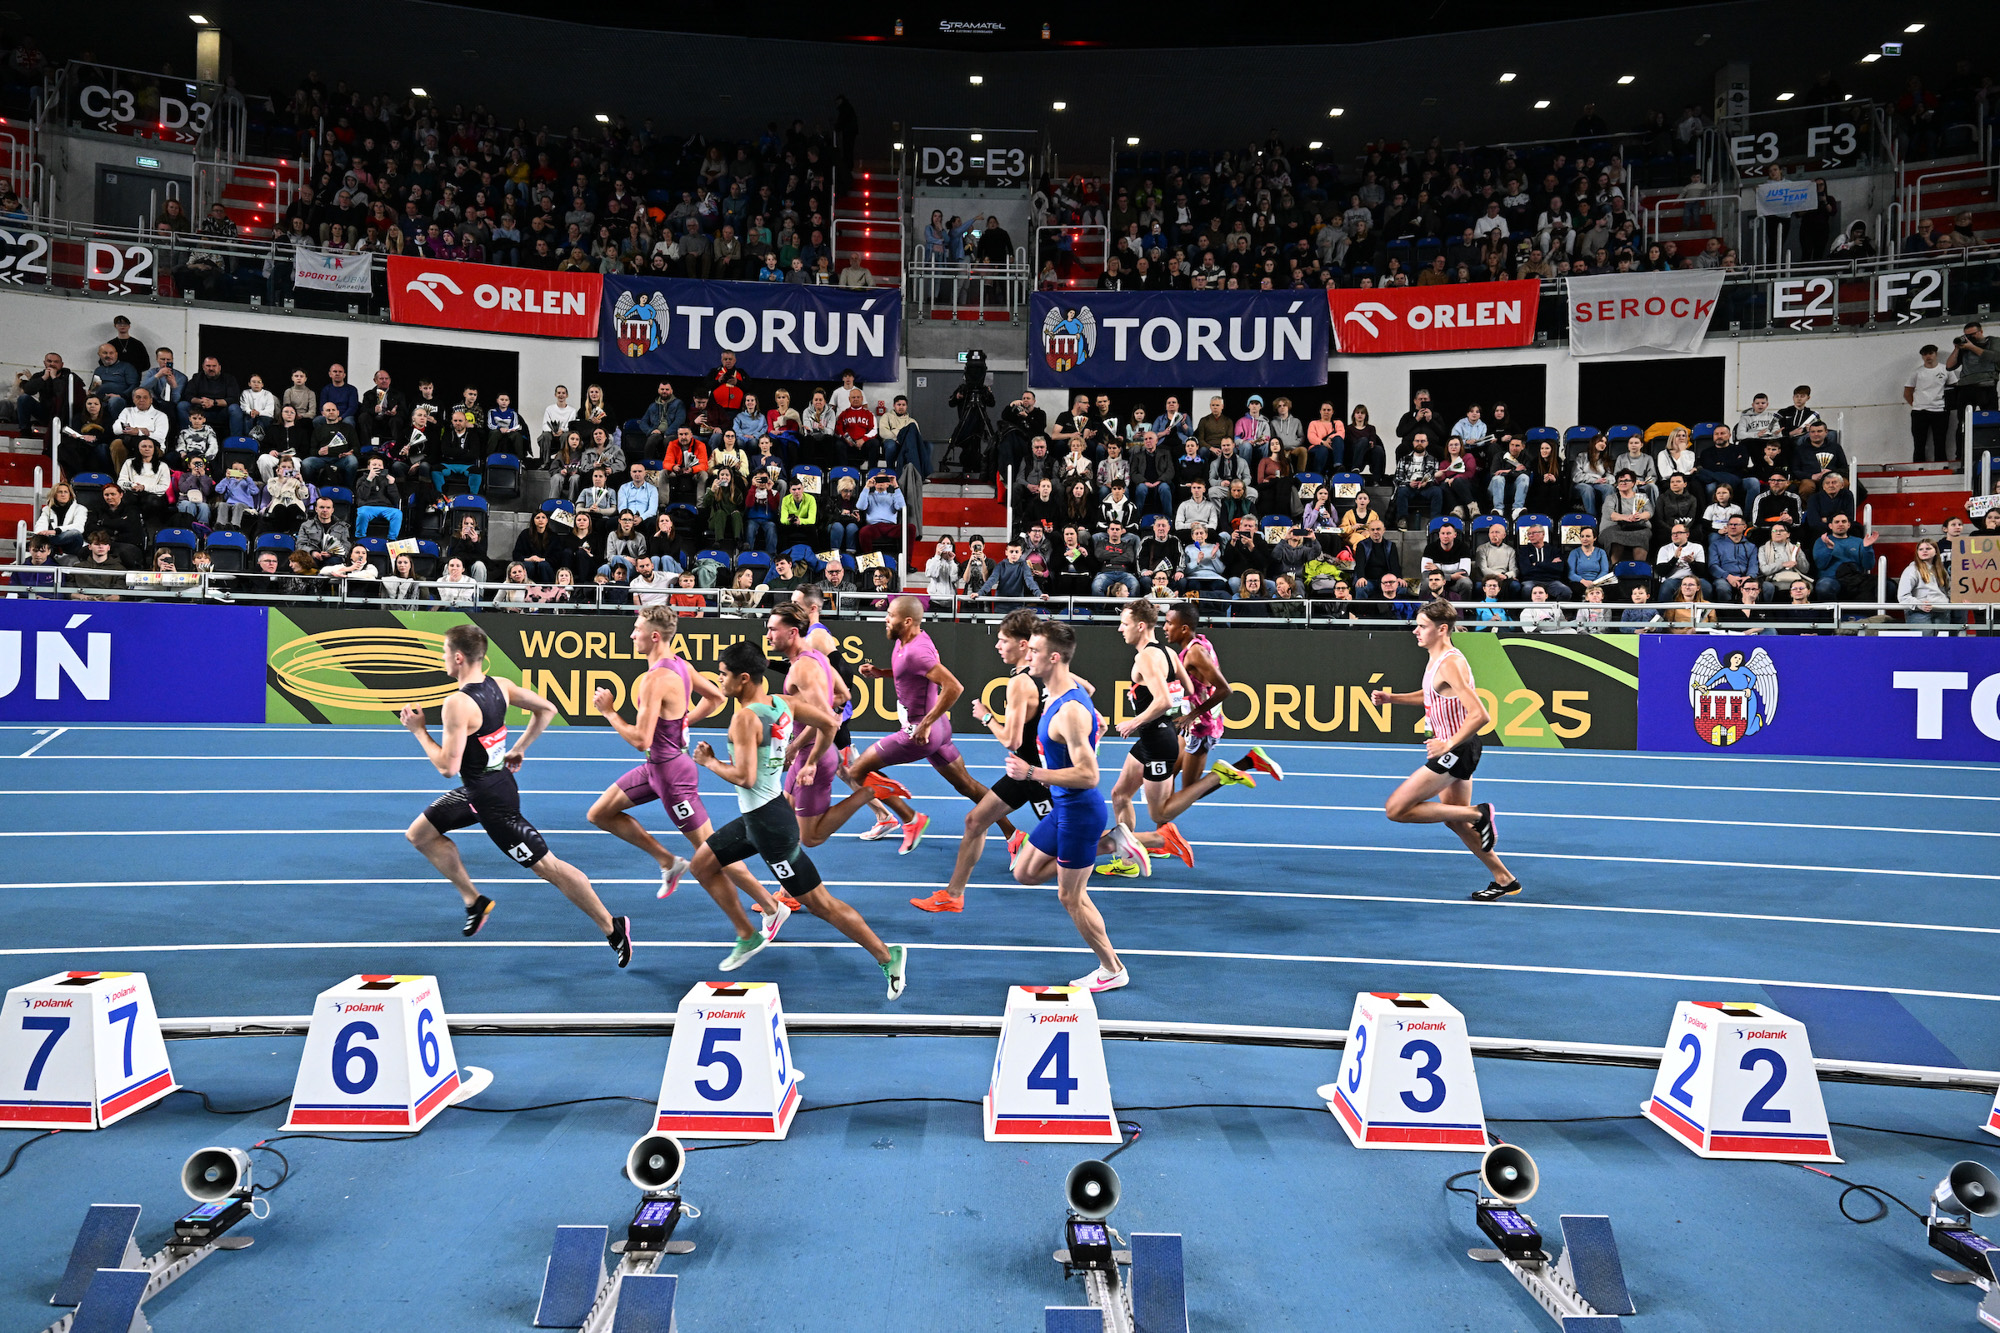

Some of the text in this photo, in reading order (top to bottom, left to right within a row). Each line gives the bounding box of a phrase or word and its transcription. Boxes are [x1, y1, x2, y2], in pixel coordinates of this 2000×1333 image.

[939, 21, 1006, 30] STRAMATEL
[80, 85, 135, 122] C3
[159, 97, 213, 134] D3
[1730, 132, 1779, 166] E3
[1807, 123, 1857, 158] F3
[922, 147, 964, 176] D3
[986, 148, 1025, 177] E3
[1765, 188, 1789, 198] JUST
[1782, 193, 1808, 202] TEAM
[87, 242, 153, 285] D2
[473, 283, 586, 316] ORLEN
[1575, 297, 1715, 323] SEROCK
[1773, 278, 1834, 318] E2
[1877, 270, 1942, 313] F2
[676, 299, 885, 358] TORUŃ
[1103, 301, 1312, 362] TORUŃ
[1407, 300, 1521, 330] ORLEN
[1962, 558, 1997, 571] EWA
[1221, 673, 1392, 733] ORUŃ
[1155, 762, 1163, 774] 6
[677, 803, 689, 817] 5
[1038, 802, 1050, 814] 2
[516, 847, 528, 860] 4
[776, 863, 789, 877] 3
[22, 1016, 71, 1091] 7
[108, 1001, 139, 1078] 7
[331, 1020, 379, 1095] 6
[417, 1008, 440, 1078] 6
[772, 1012, 786, 1086] 5
[694, 1027, 743, 1101] 5
[1027, 1031, 1079, 1105] 4
[1348, 1024, 1367, 1094] 3
[1399, 1039, 1447, 1113] 3
[1669, 1033, 1702, 1108] 2
[1739, 1047, 1791, 1123] 2
